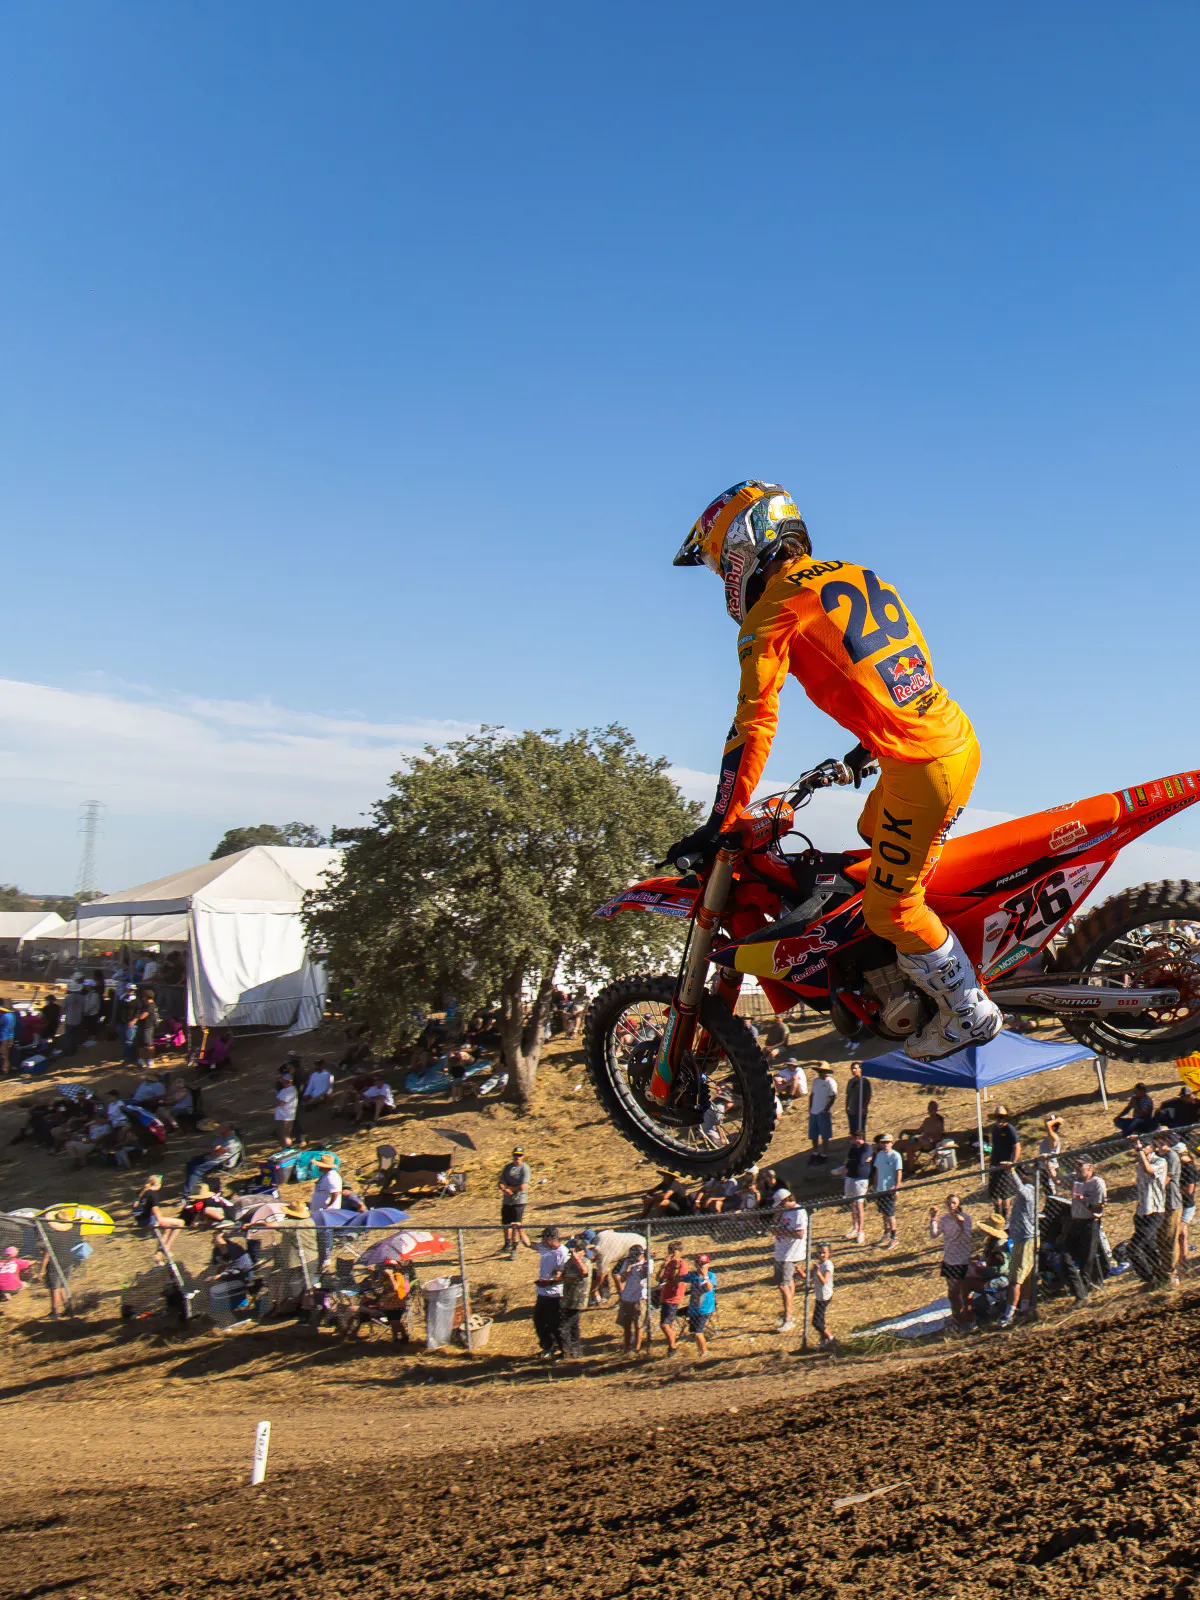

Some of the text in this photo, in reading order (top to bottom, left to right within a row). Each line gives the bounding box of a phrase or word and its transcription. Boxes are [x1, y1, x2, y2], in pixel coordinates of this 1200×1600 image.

[786, 559, 854, 587] PRAD
[820, 569, 910, 664] 26
[893, 675, 920, 702] Red
[1148, 795, 1196, 822] DUNLOP
[996, 868, 1028, 887] PRADO
[1003, 871, 1072, 941] 26
[941, 961, 962, 984] FOX
[999, 948, 1028, 970] MOTOREX
[662, 1014, 676, 1053] MOTOREX
